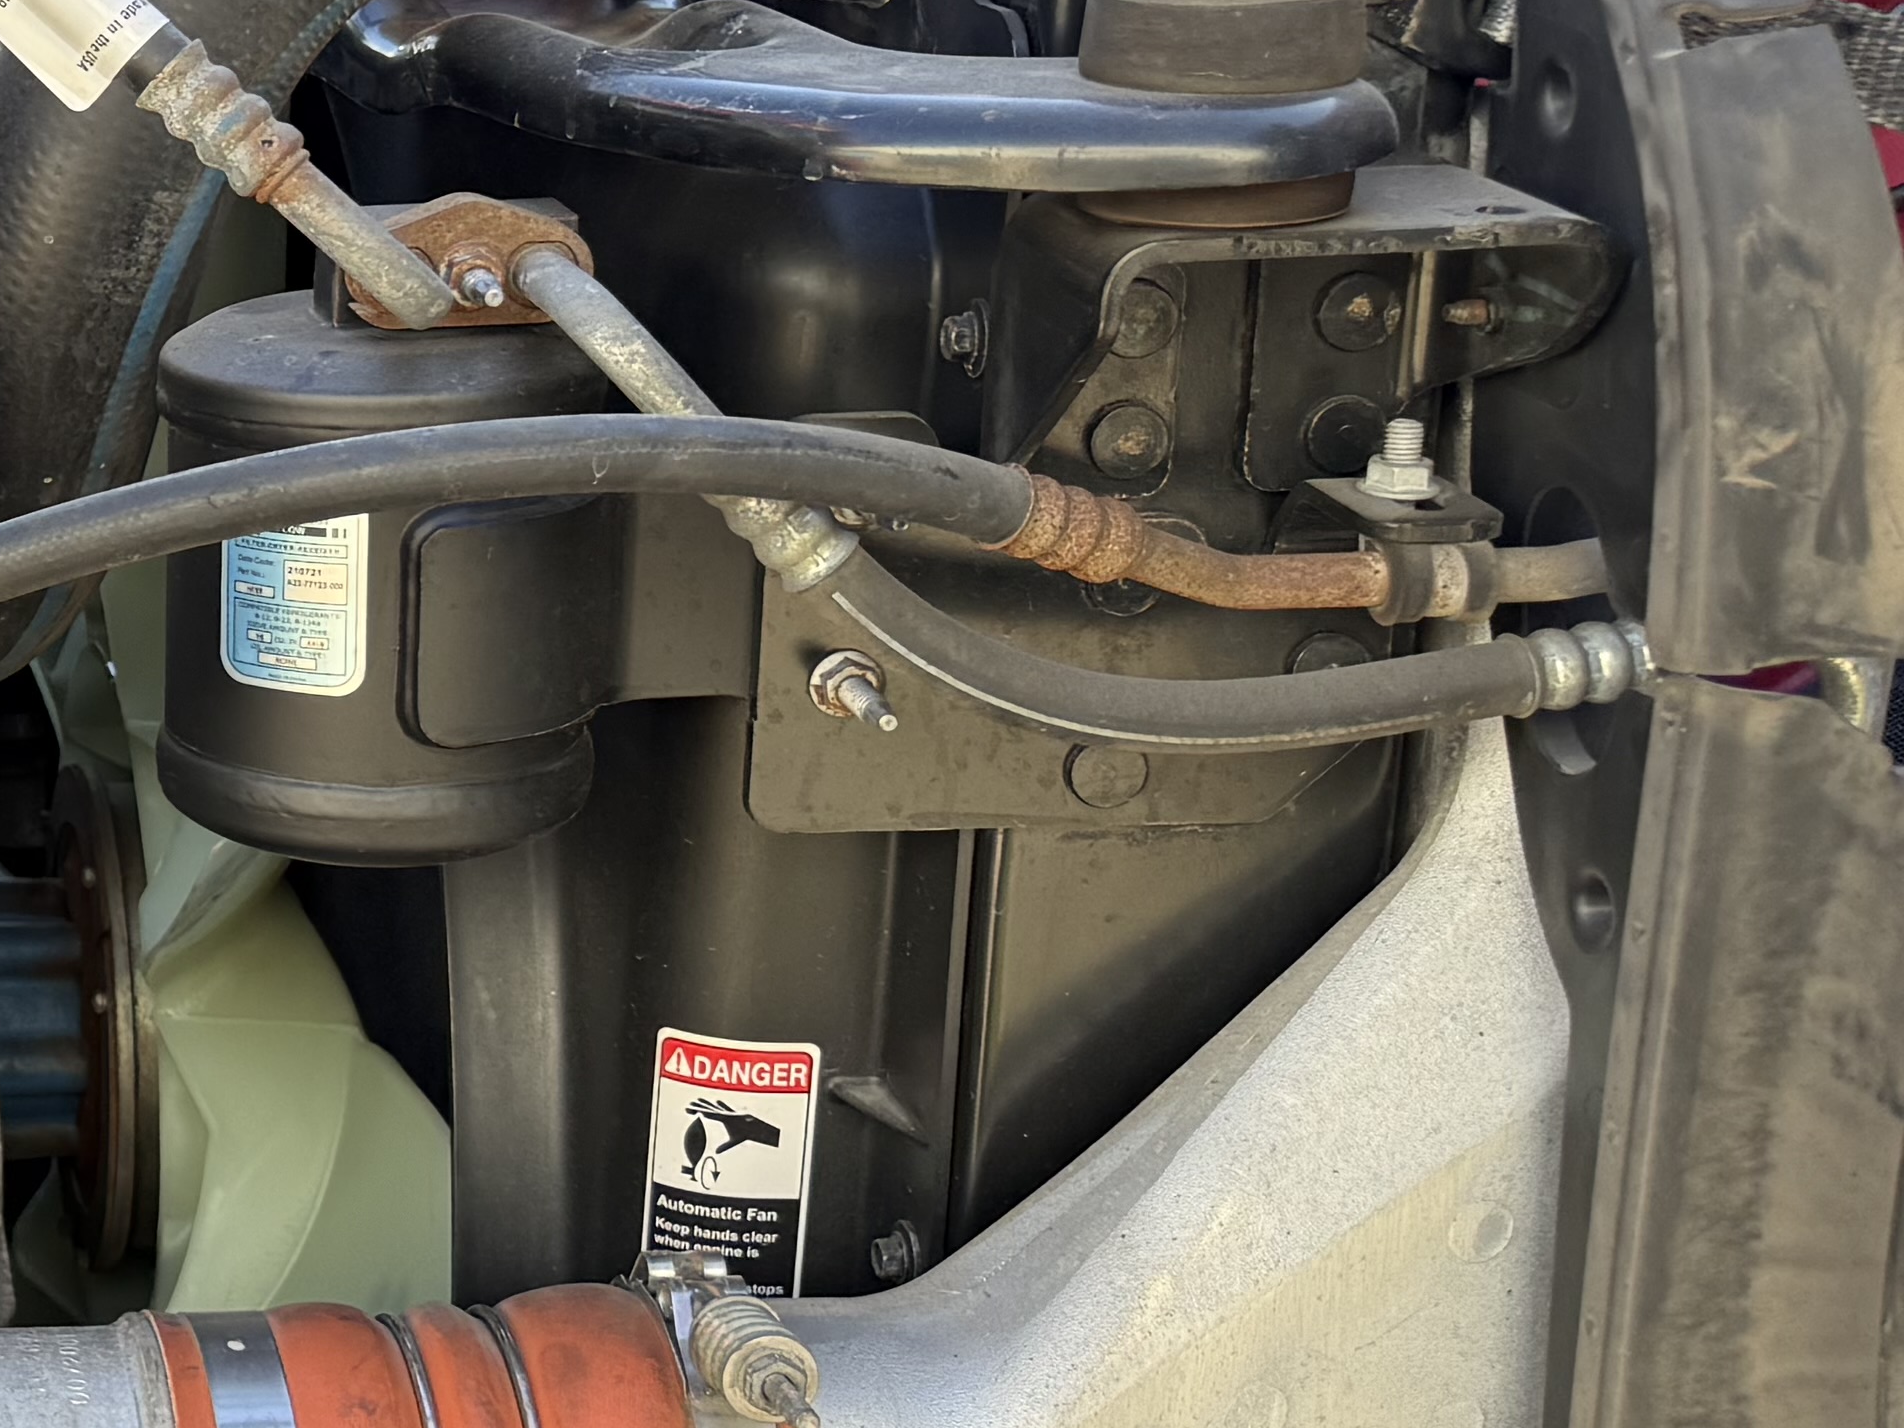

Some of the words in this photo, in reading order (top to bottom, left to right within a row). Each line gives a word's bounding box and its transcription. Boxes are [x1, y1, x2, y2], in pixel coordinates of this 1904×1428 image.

[693, 1056, 809, 1088] DANGER
[656, 1193, 743, 1221] Automatic
[745, 1207, 779, 1223] Fan
[654, 1215, 691, 1238] Keep
[693, 1224, 740, 1243] hands
[741, 1230, 780, 1244] clear
[653, 1233, 691, 1252] when
[745, 1245, 761, 1259] is
